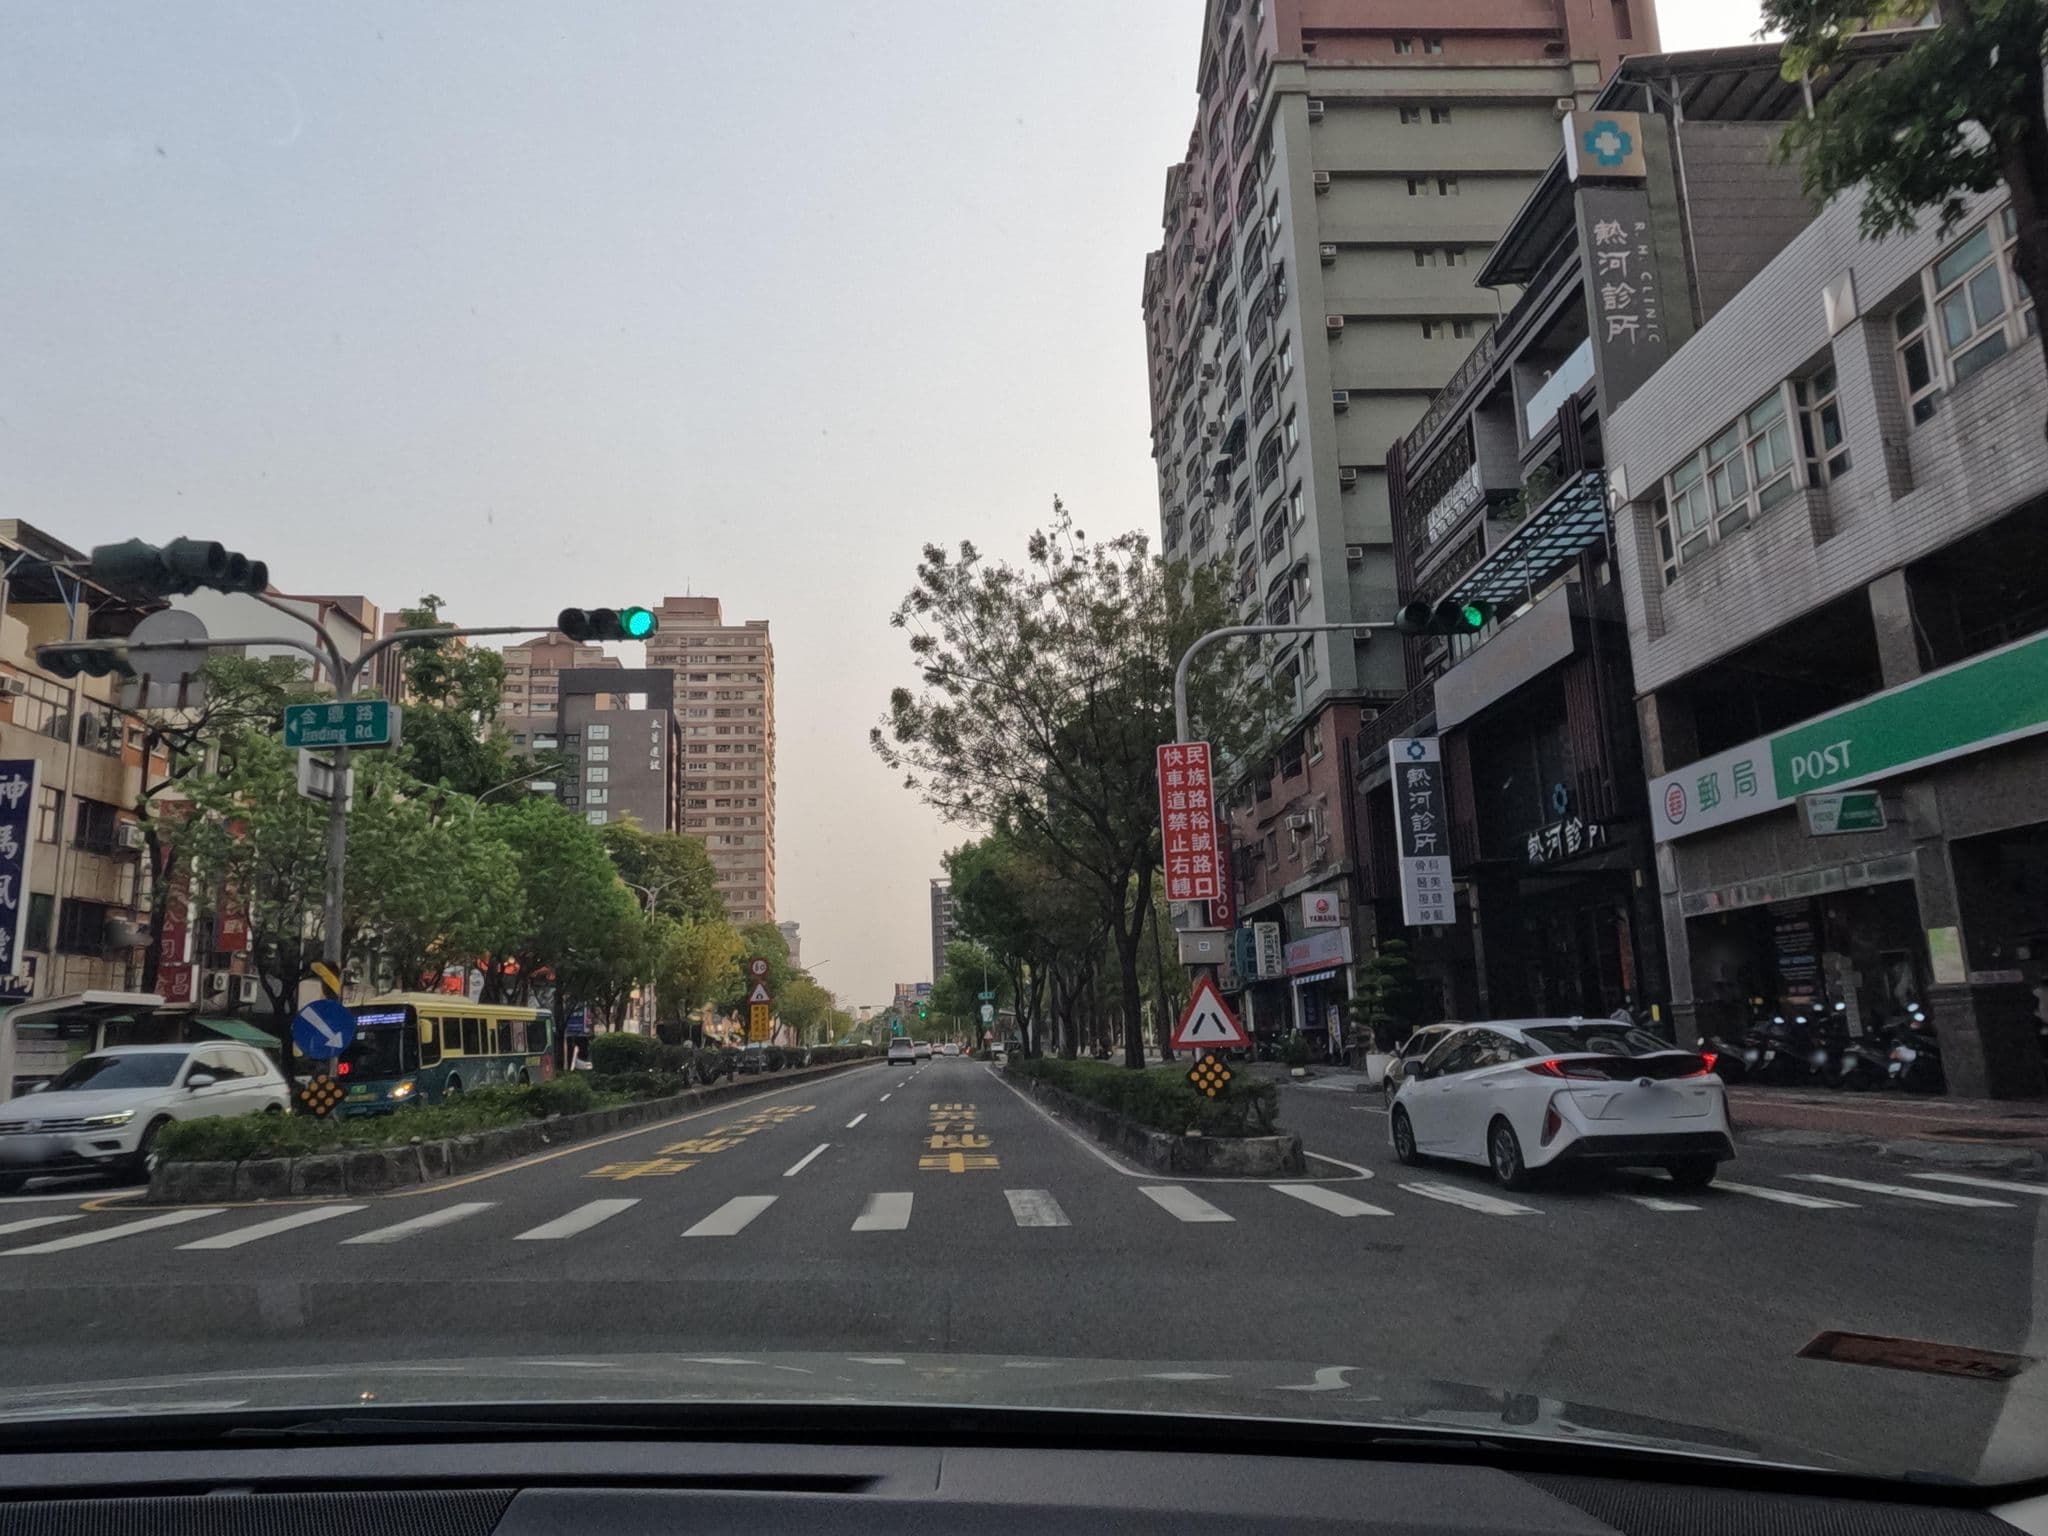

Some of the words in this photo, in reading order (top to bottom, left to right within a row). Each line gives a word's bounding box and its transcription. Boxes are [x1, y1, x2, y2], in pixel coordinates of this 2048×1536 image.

[1593, 219, 1640, 344] 熱河診所
[1640, 271, 1661, 343] CLINIC
[1405, 767, 1438, 854] 熱河診所
[1697, 759, 1759, 812] 郵局
[1790, 739, 1852, 785] POST
[1164, 748, 1191, 897] 快車道禁止右轉
[1186, 746, 1213, 896] 民族路裕誠路口
[1309, 914, 1337, 922] YAMAHA
